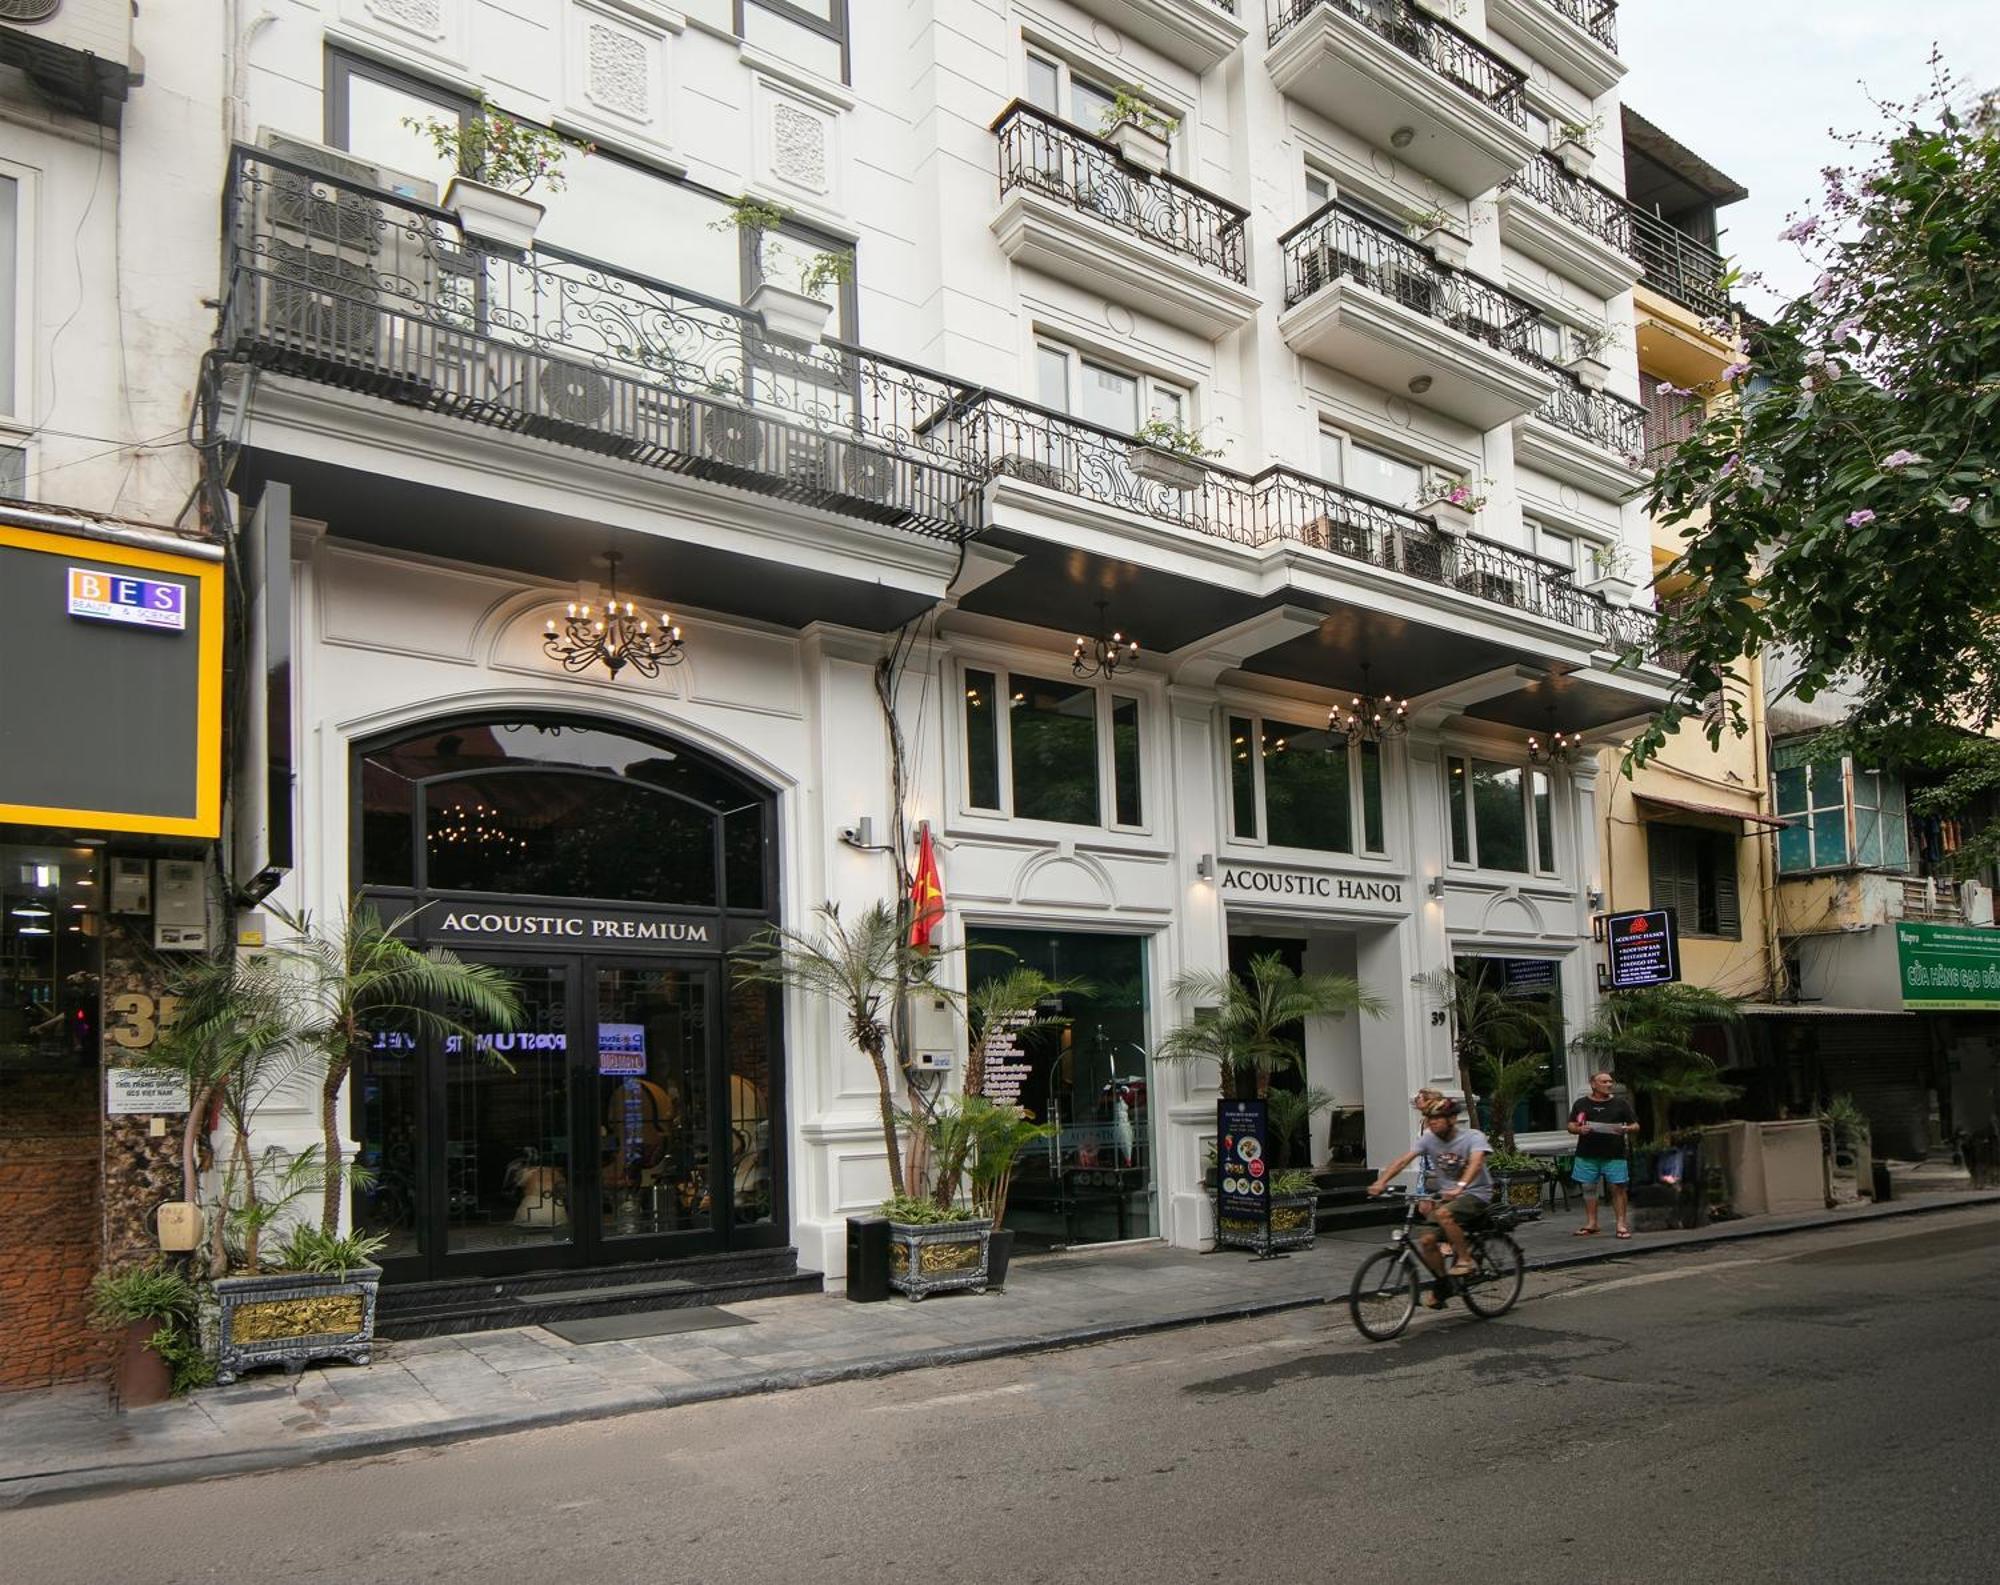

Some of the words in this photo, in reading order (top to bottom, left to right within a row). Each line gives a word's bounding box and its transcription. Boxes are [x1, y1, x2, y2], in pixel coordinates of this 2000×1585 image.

[73, 600, 113, 612] BEAUTY
[82, 576, 174, 609] BES
[1221, 868, 1330, 897] ACOUSTIC
[1337, 879, 1402, 902] HANOI
[440, 913, 583, 936] ACOUSTIC
[591, 919, 709, 942] PREMIUM
[1431, 1011, 1446, 1026] 39
